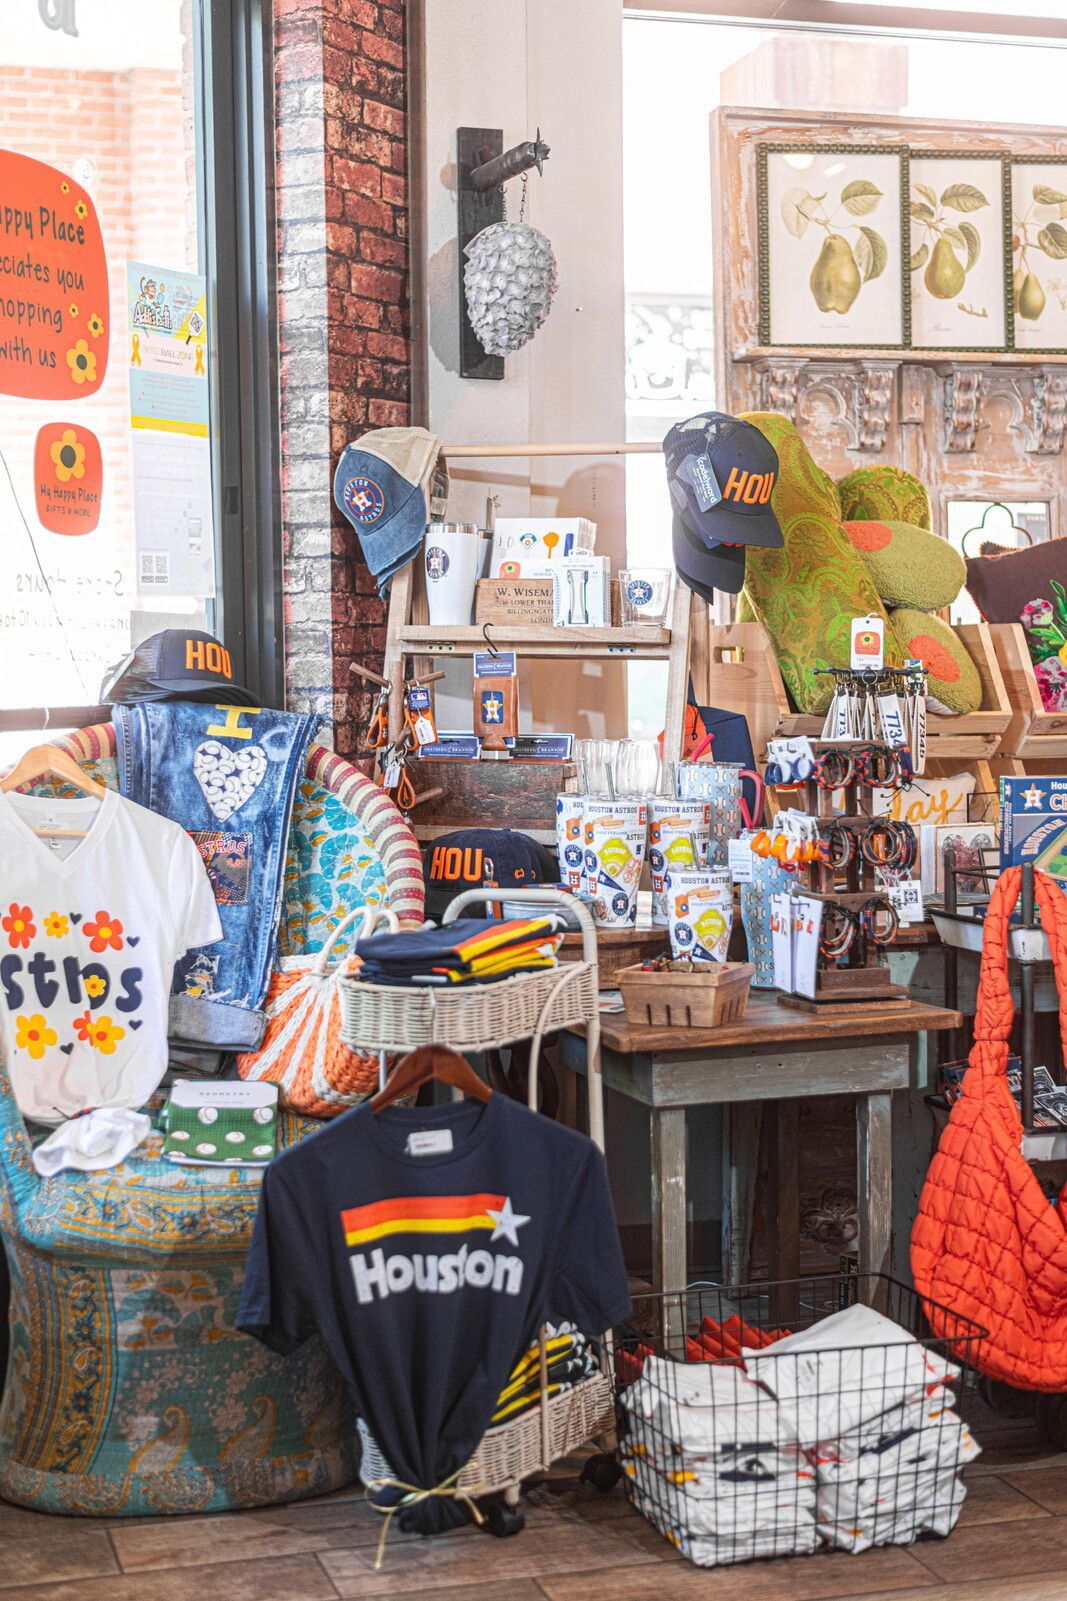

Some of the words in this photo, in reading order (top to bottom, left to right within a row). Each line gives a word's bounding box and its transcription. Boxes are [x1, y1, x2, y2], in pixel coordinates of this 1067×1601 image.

[0, 206, 33, 239] ppy
[39, 206, 85, 245] Place
[0, 253, 49, 283] ciates
[57, 268, 84, 294] you
[39, 348, 56, 368] us
[54, 484, 76, 503] Happy
[79, 487, 98, 503] Place
[723, 466, 775, 505] HOU
[497, 588, 511, 597] W.
[514, 588, 553, 597] WISEM
[186, 639, 232, 680] HOU
[615, 806, 638, 814] ASTROS
[654, 805, 680, 813] HOUSTON
[681, 805, 704, 813] ASTROS
[1021, 818, 1066, 856] HOUSTON
[429, 846, 483, 882] HOU
[681, 876, 709, 885] HOUSTON
[711, 876, 731, 885] ASTROS
[350, 1243, 524, 1304] Houston
